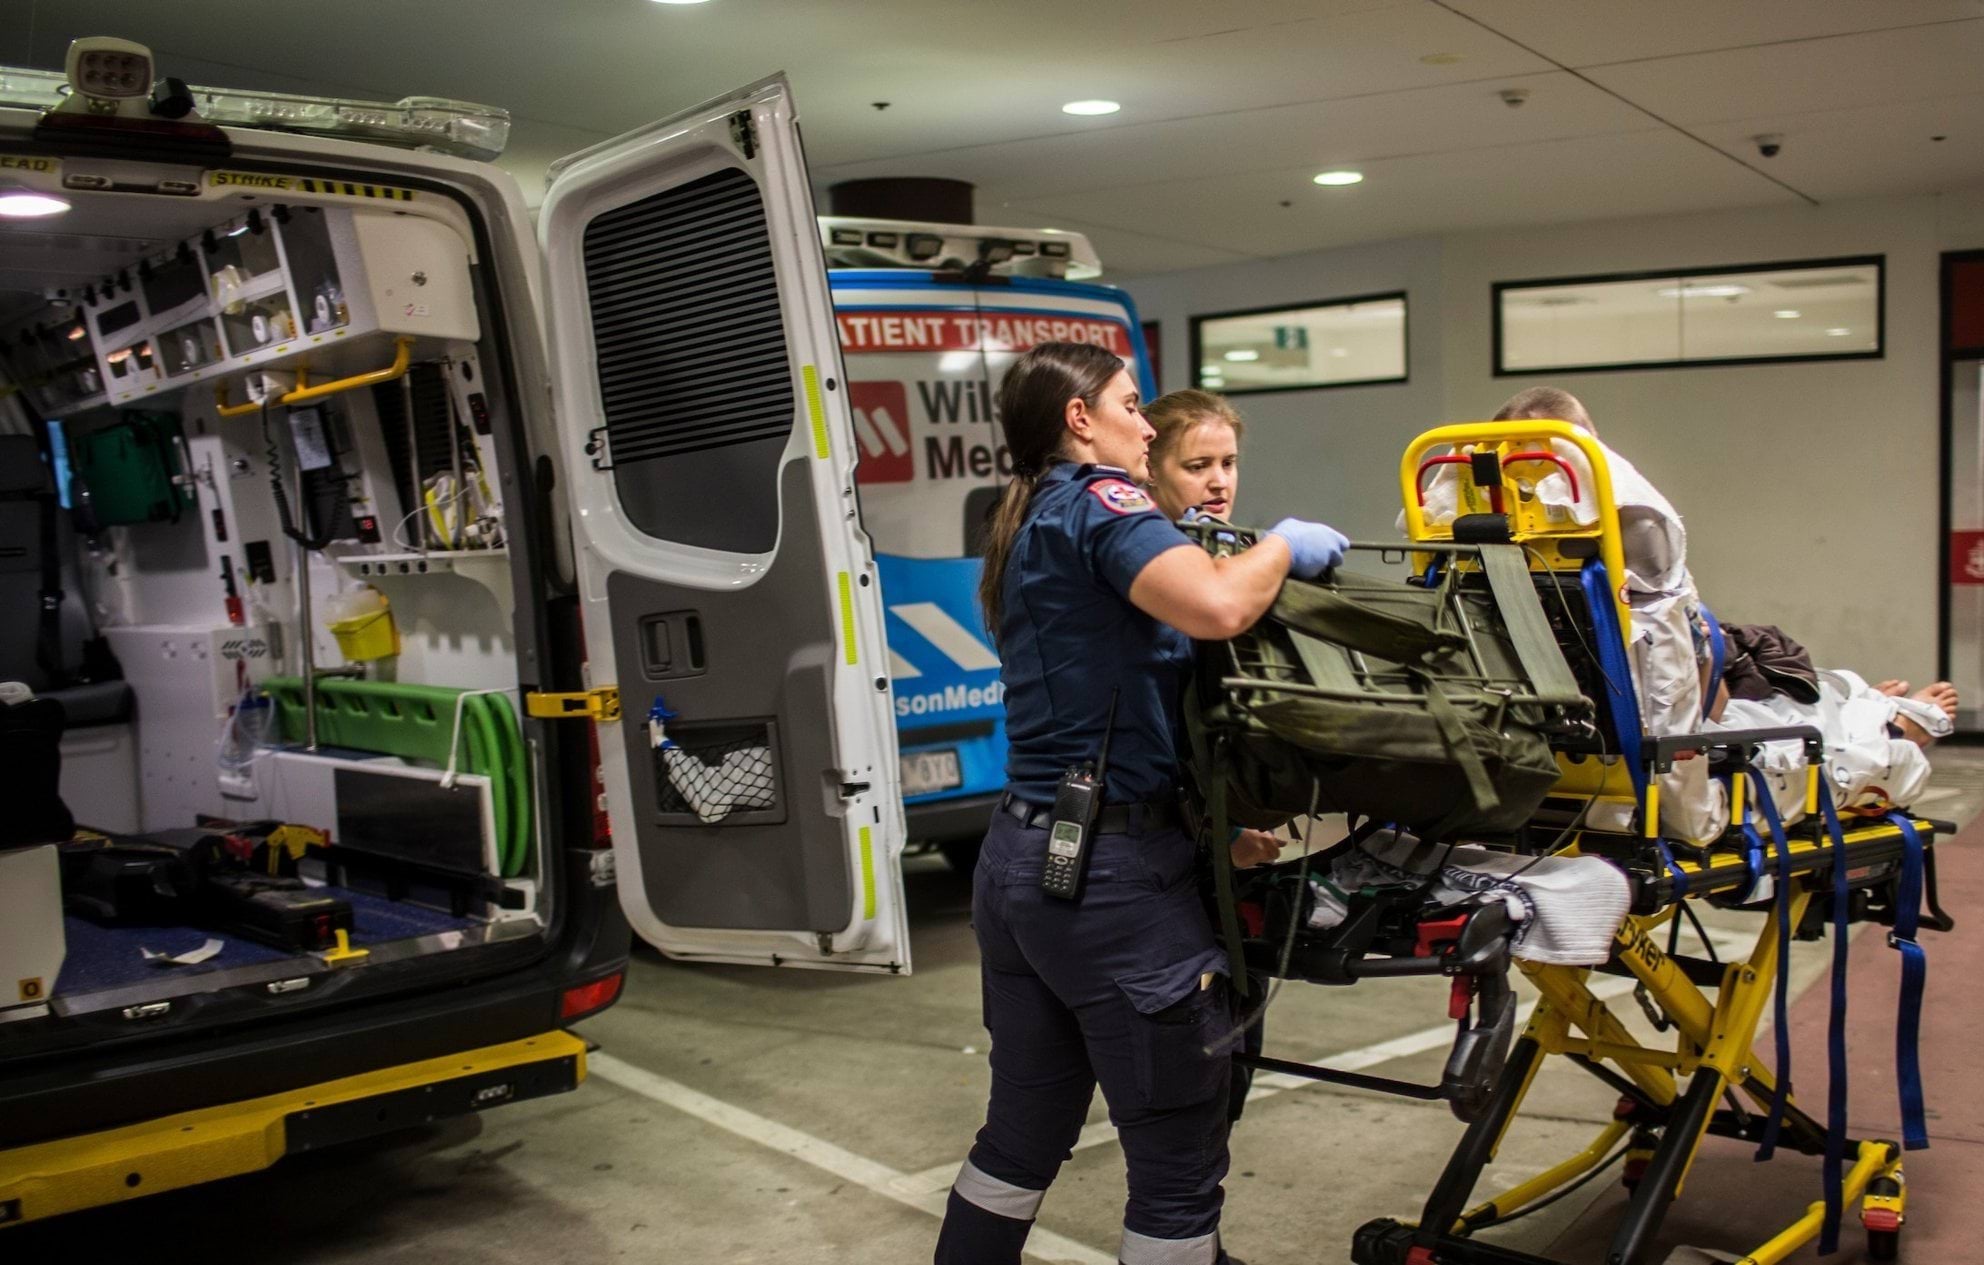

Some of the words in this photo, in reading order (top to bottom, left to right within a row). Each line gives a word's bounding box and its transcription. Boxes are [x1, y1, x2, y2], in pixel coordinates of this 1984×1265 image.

[1, 157, 48, 171] EAD
[216, 172, 288, 188] STRIKE
[953, 319, 1117, 350] TRANSPORT
[1617, 916, 1665, 972] ryker
